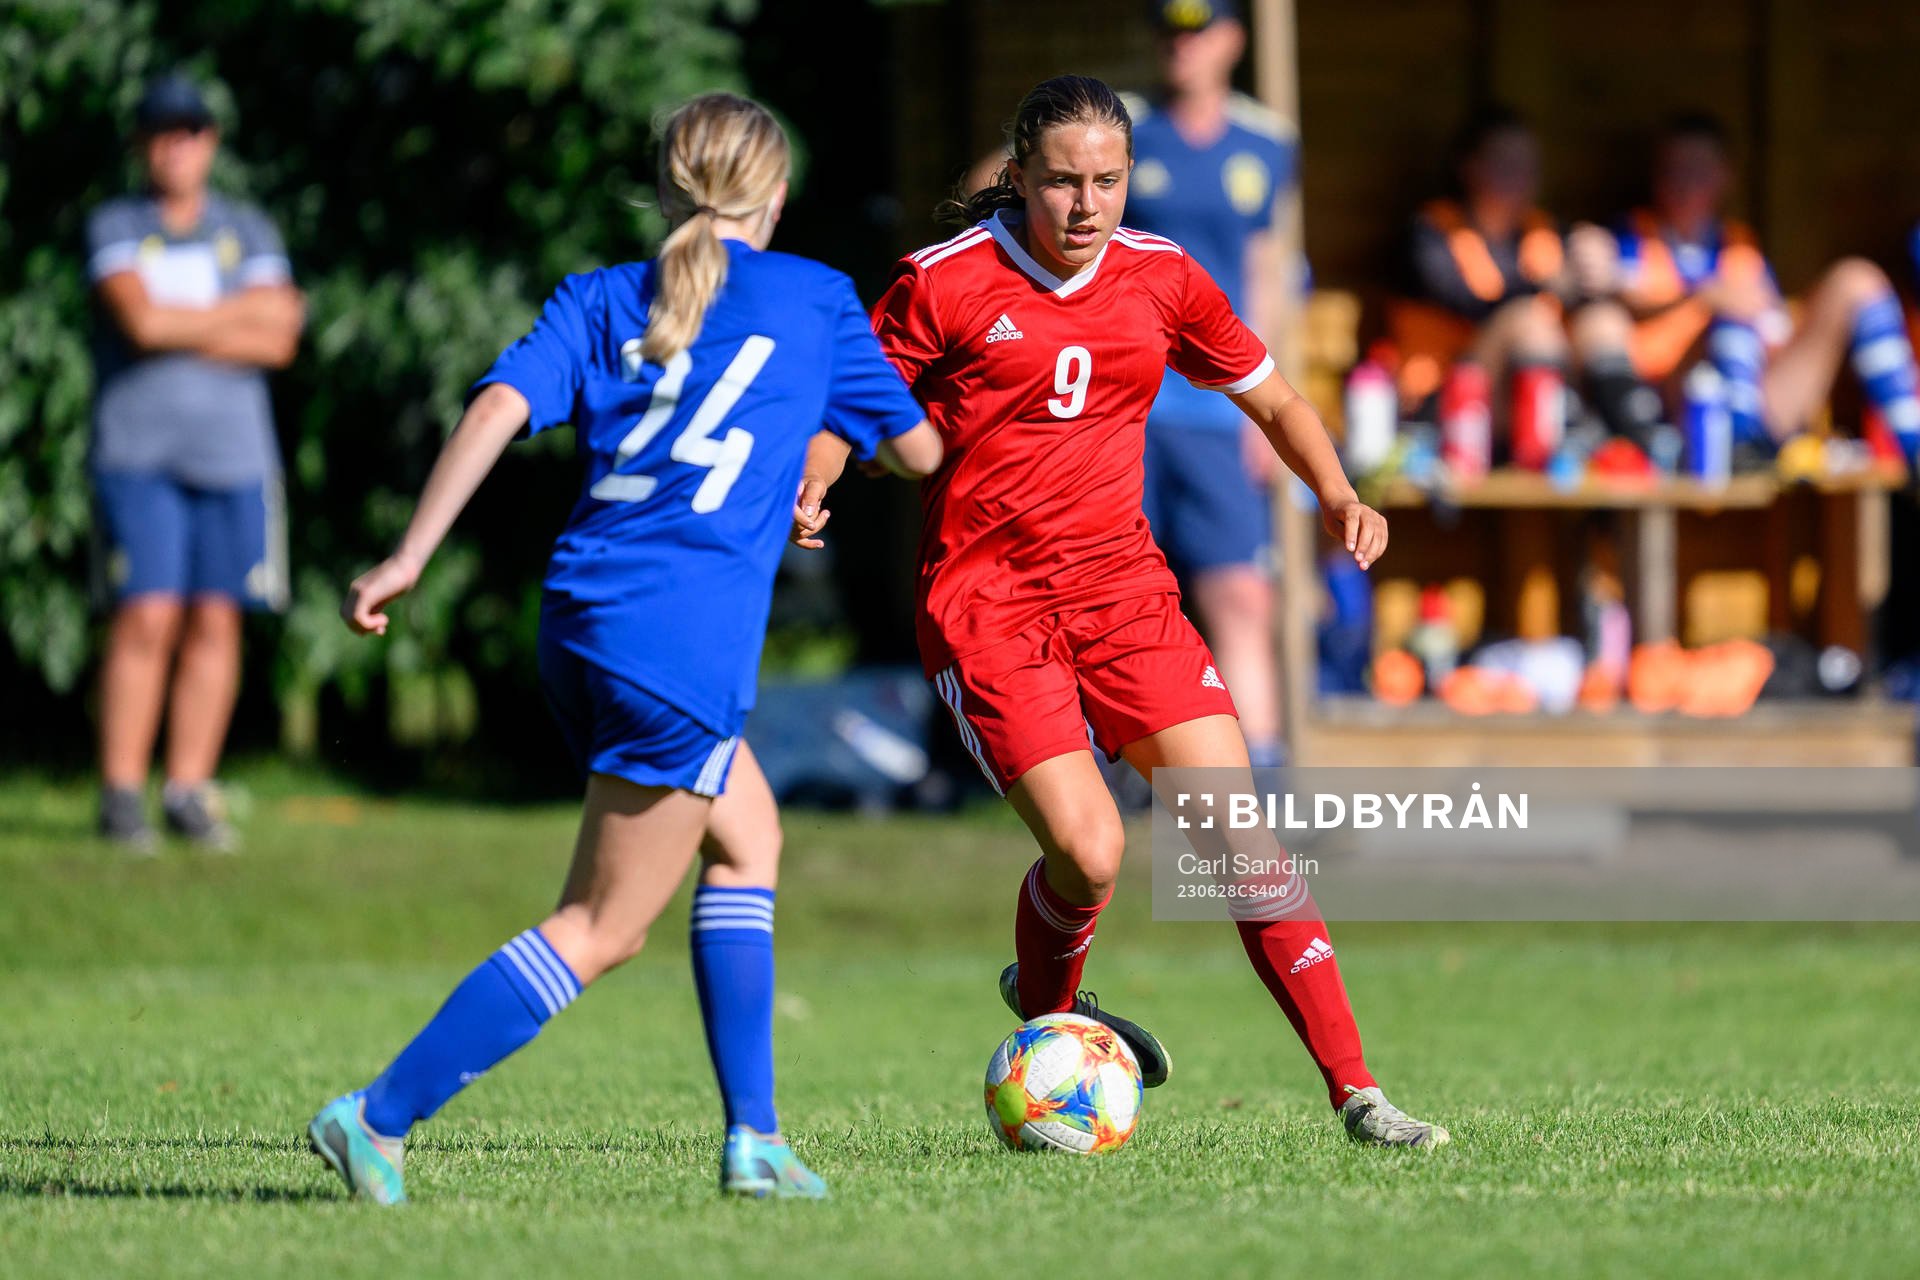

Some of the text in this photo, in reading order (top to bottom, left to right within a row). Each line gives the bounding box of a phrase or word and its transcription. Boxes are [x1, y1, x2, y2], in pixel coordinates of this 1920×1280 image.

[986, 330, 1023, 343] adidas
[1048, 346, 1092, 418] 9
[590, 335, 775, 513] 24
